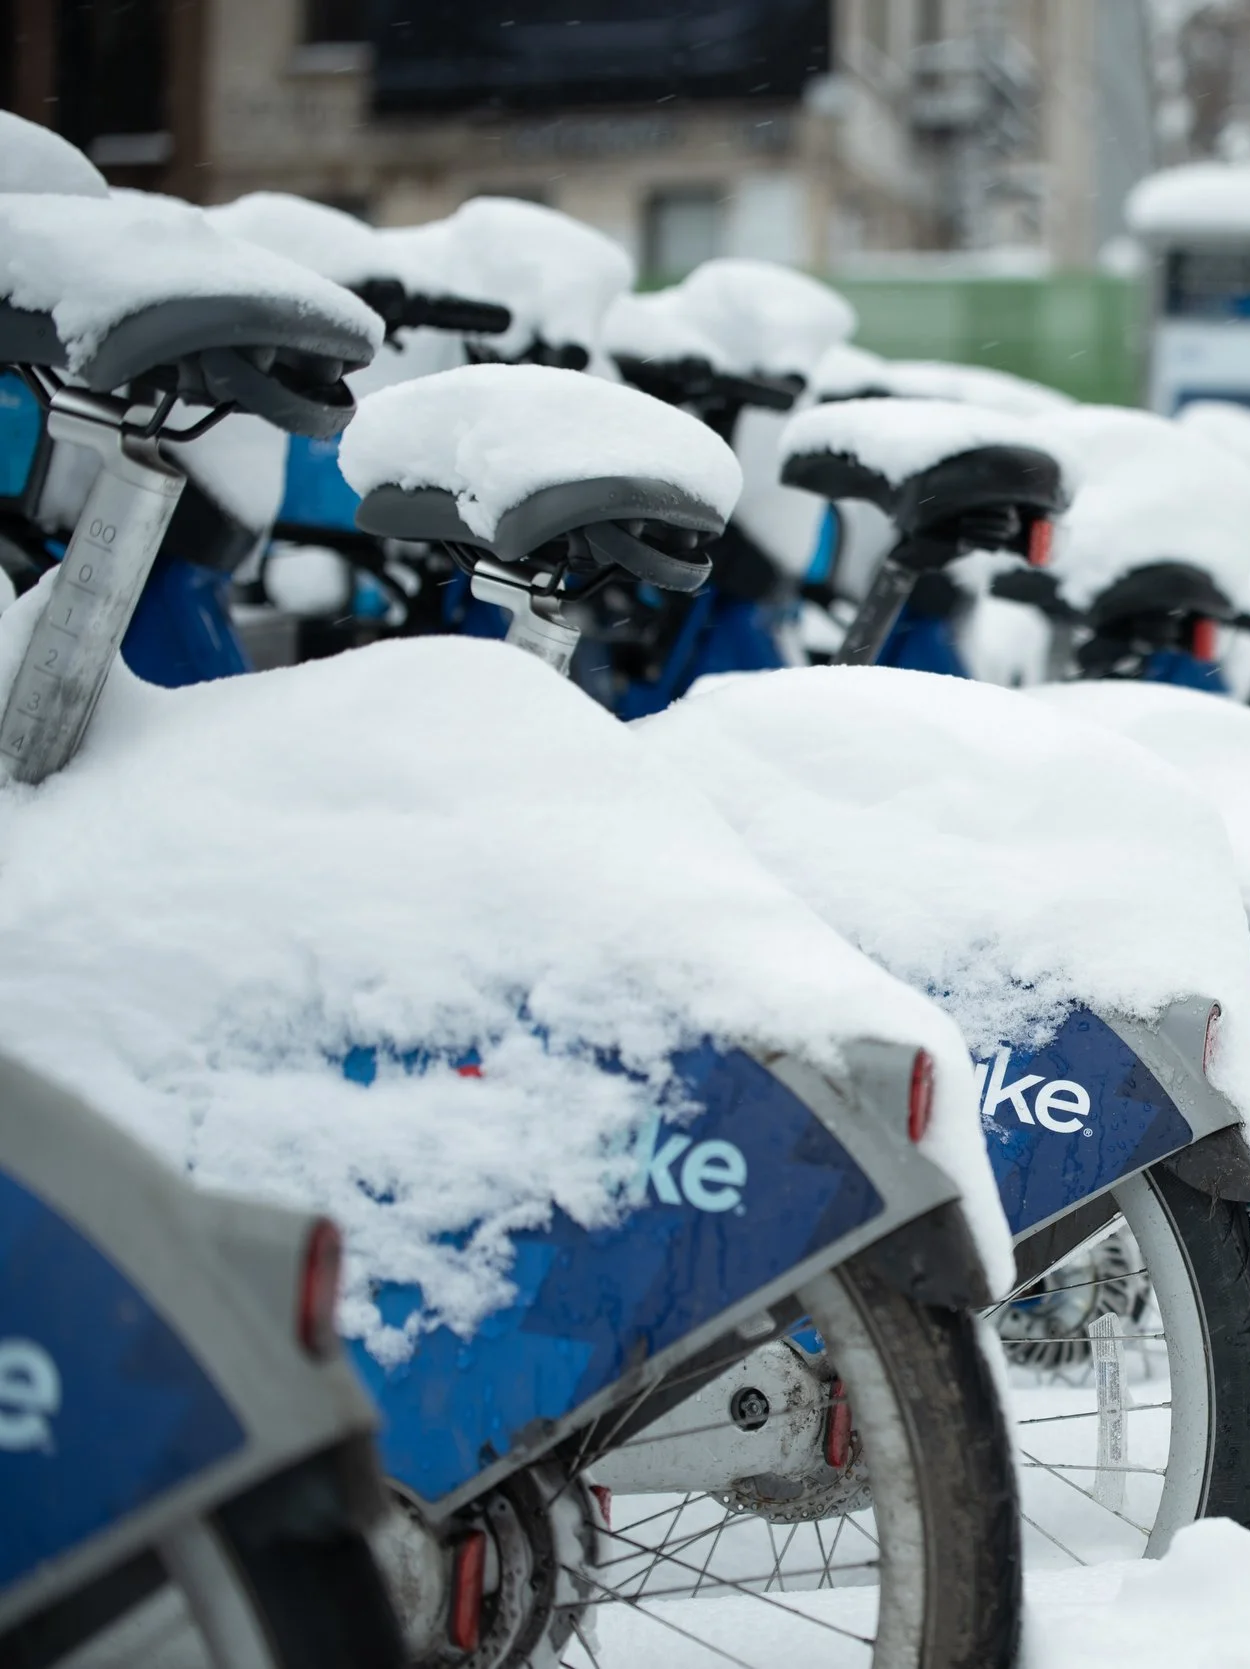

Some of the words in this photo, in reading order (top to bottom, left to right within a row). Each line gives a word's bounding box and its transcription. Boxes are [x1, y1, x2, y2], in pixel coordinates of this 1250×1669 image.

[44, 648, 59, 668] 2
[26, 691, 41, 712] 3
[10, 734, 25, 753] 4
[608, 1110, 747, 1213] ke
